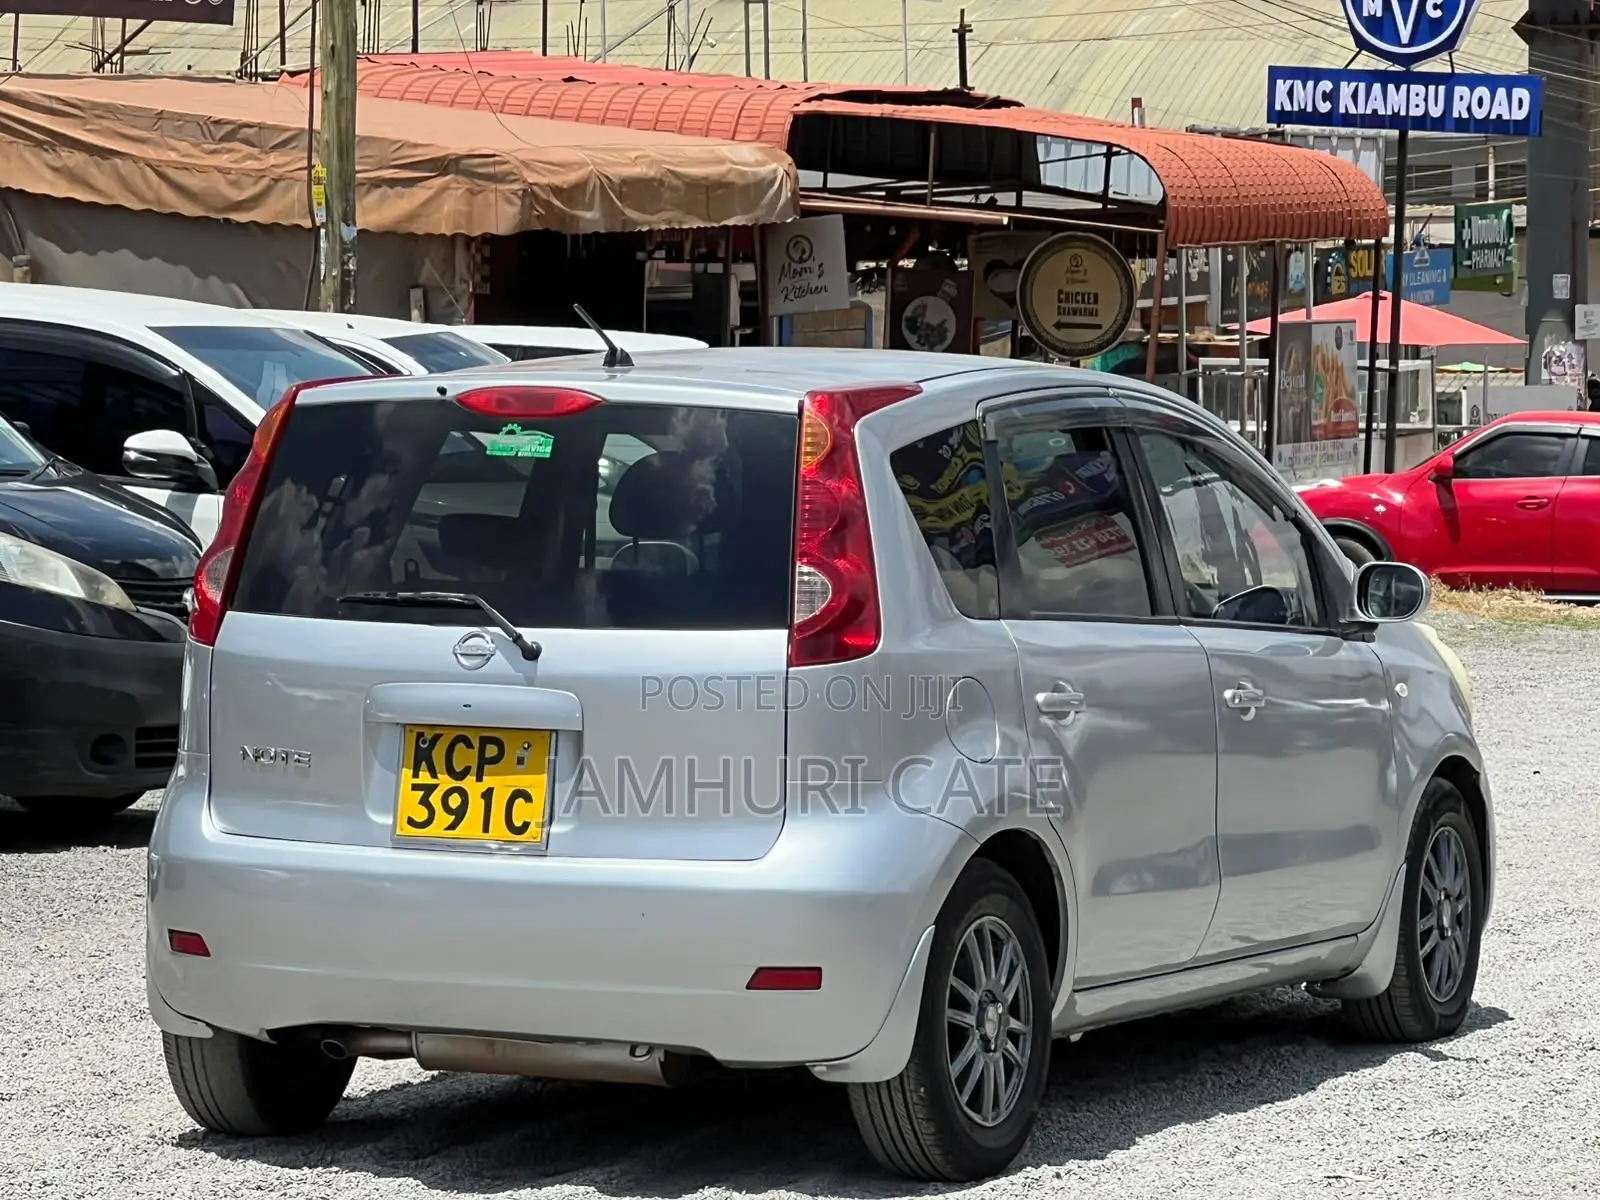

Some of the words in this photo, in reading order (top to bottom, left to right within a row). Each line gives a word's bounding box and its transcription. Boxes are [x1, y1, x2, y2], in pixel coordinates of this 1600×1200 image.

[1275, 79, 1333, 113] KMC
[1339, 81, 1446, 118] KIAMBU
[1452, 85, 1530, 120] ROAD
[777, 255, 825, 285] Mom's
[1471, 248, 1506, 270] PHARMACY
[780, 281, 829, 303] Kitchen
[1057, 289, 1099, 305] CHICKEN
[1057, 305, 1099, 317] SHAWARMA
[240, 745, 312, 768] NOTE
[411, 731, 506, 783] KCP
[406, 783, 534, 836] 391C
